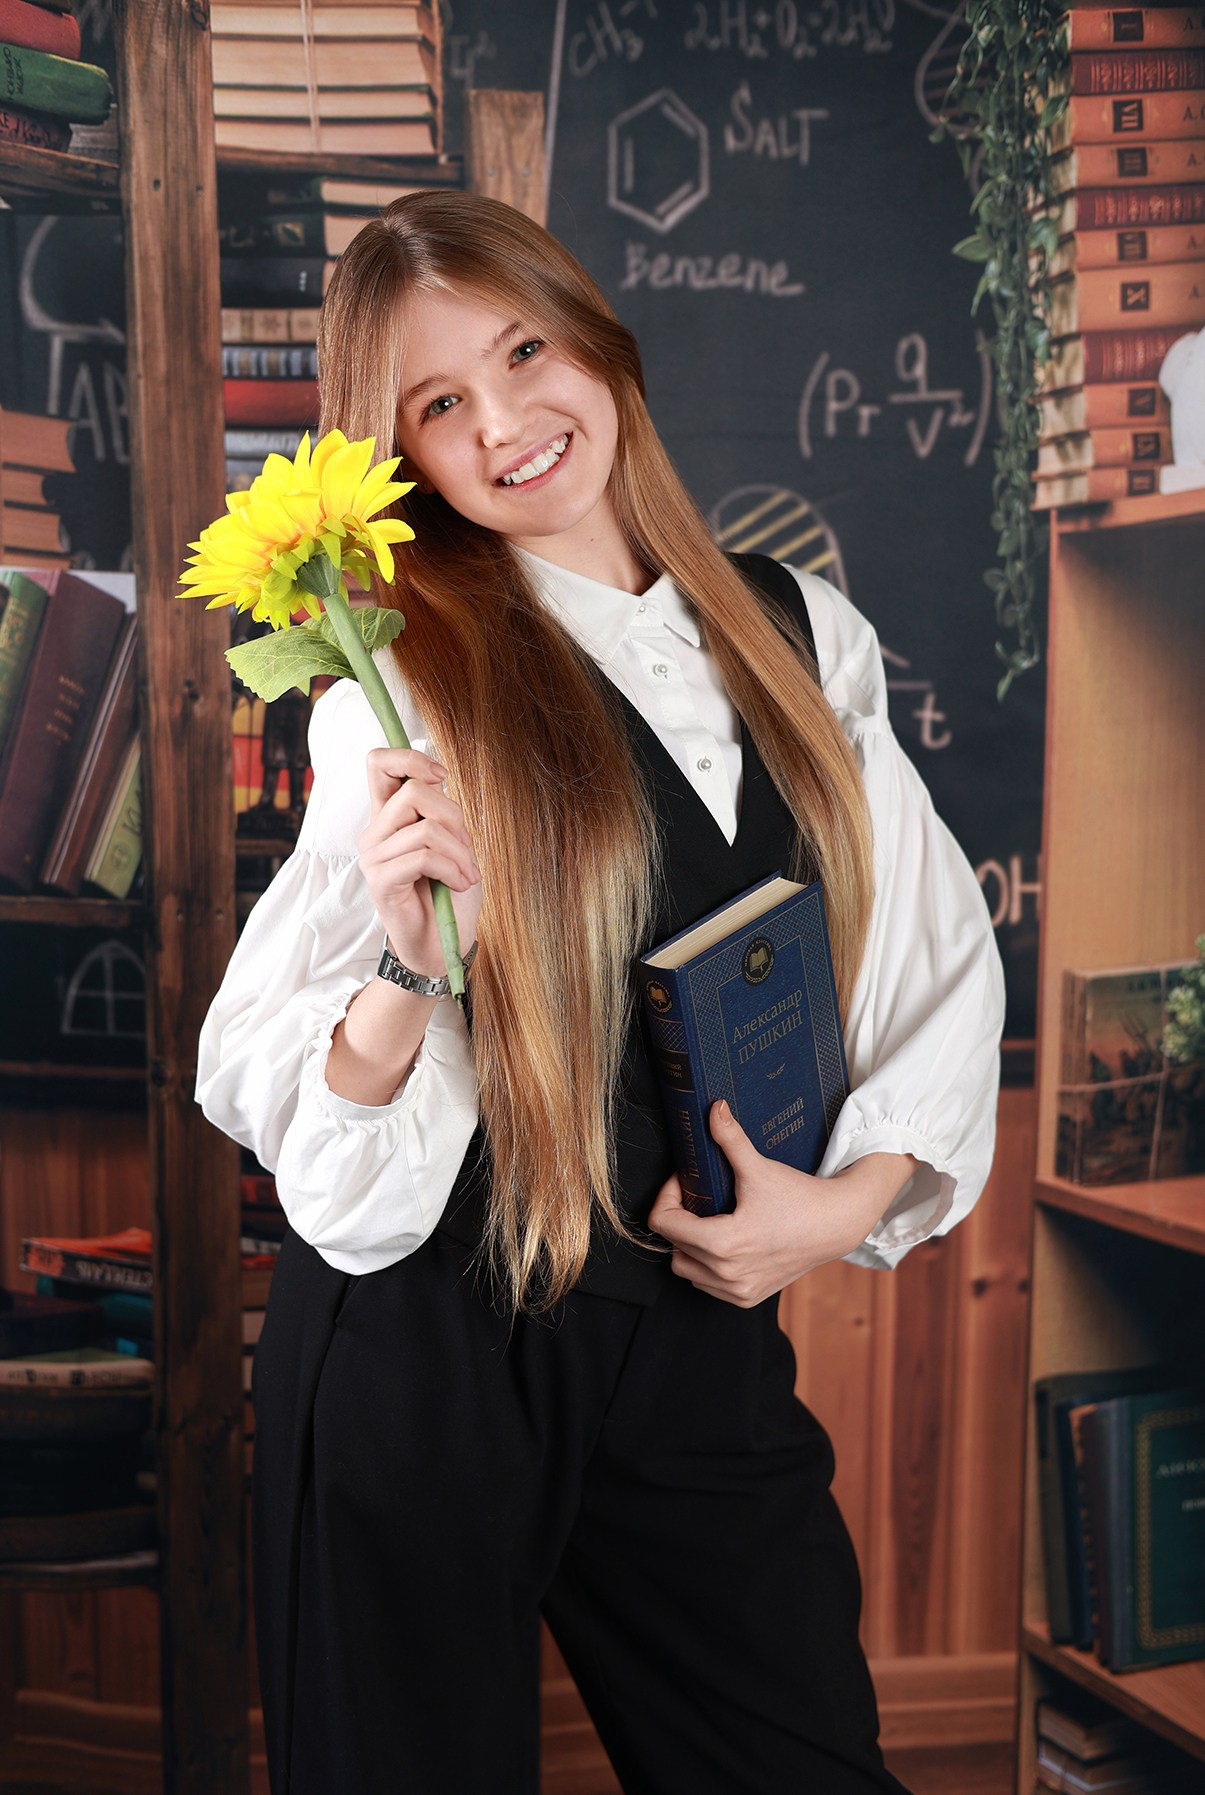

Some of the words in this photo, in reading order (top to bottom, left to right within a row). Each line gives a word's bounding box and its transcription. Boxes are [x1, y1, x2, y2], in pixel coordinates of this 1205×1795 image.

[619, 240, 806, 296] Benzene
[733, 989, 803, 1044] Александр
[738, 1010, 803, 1065] ПУШКИН
[761, 1096, 804, 1136] ЕВГЕНИЙ
[766, 1115, 805, 1150] ОНЕГИН
